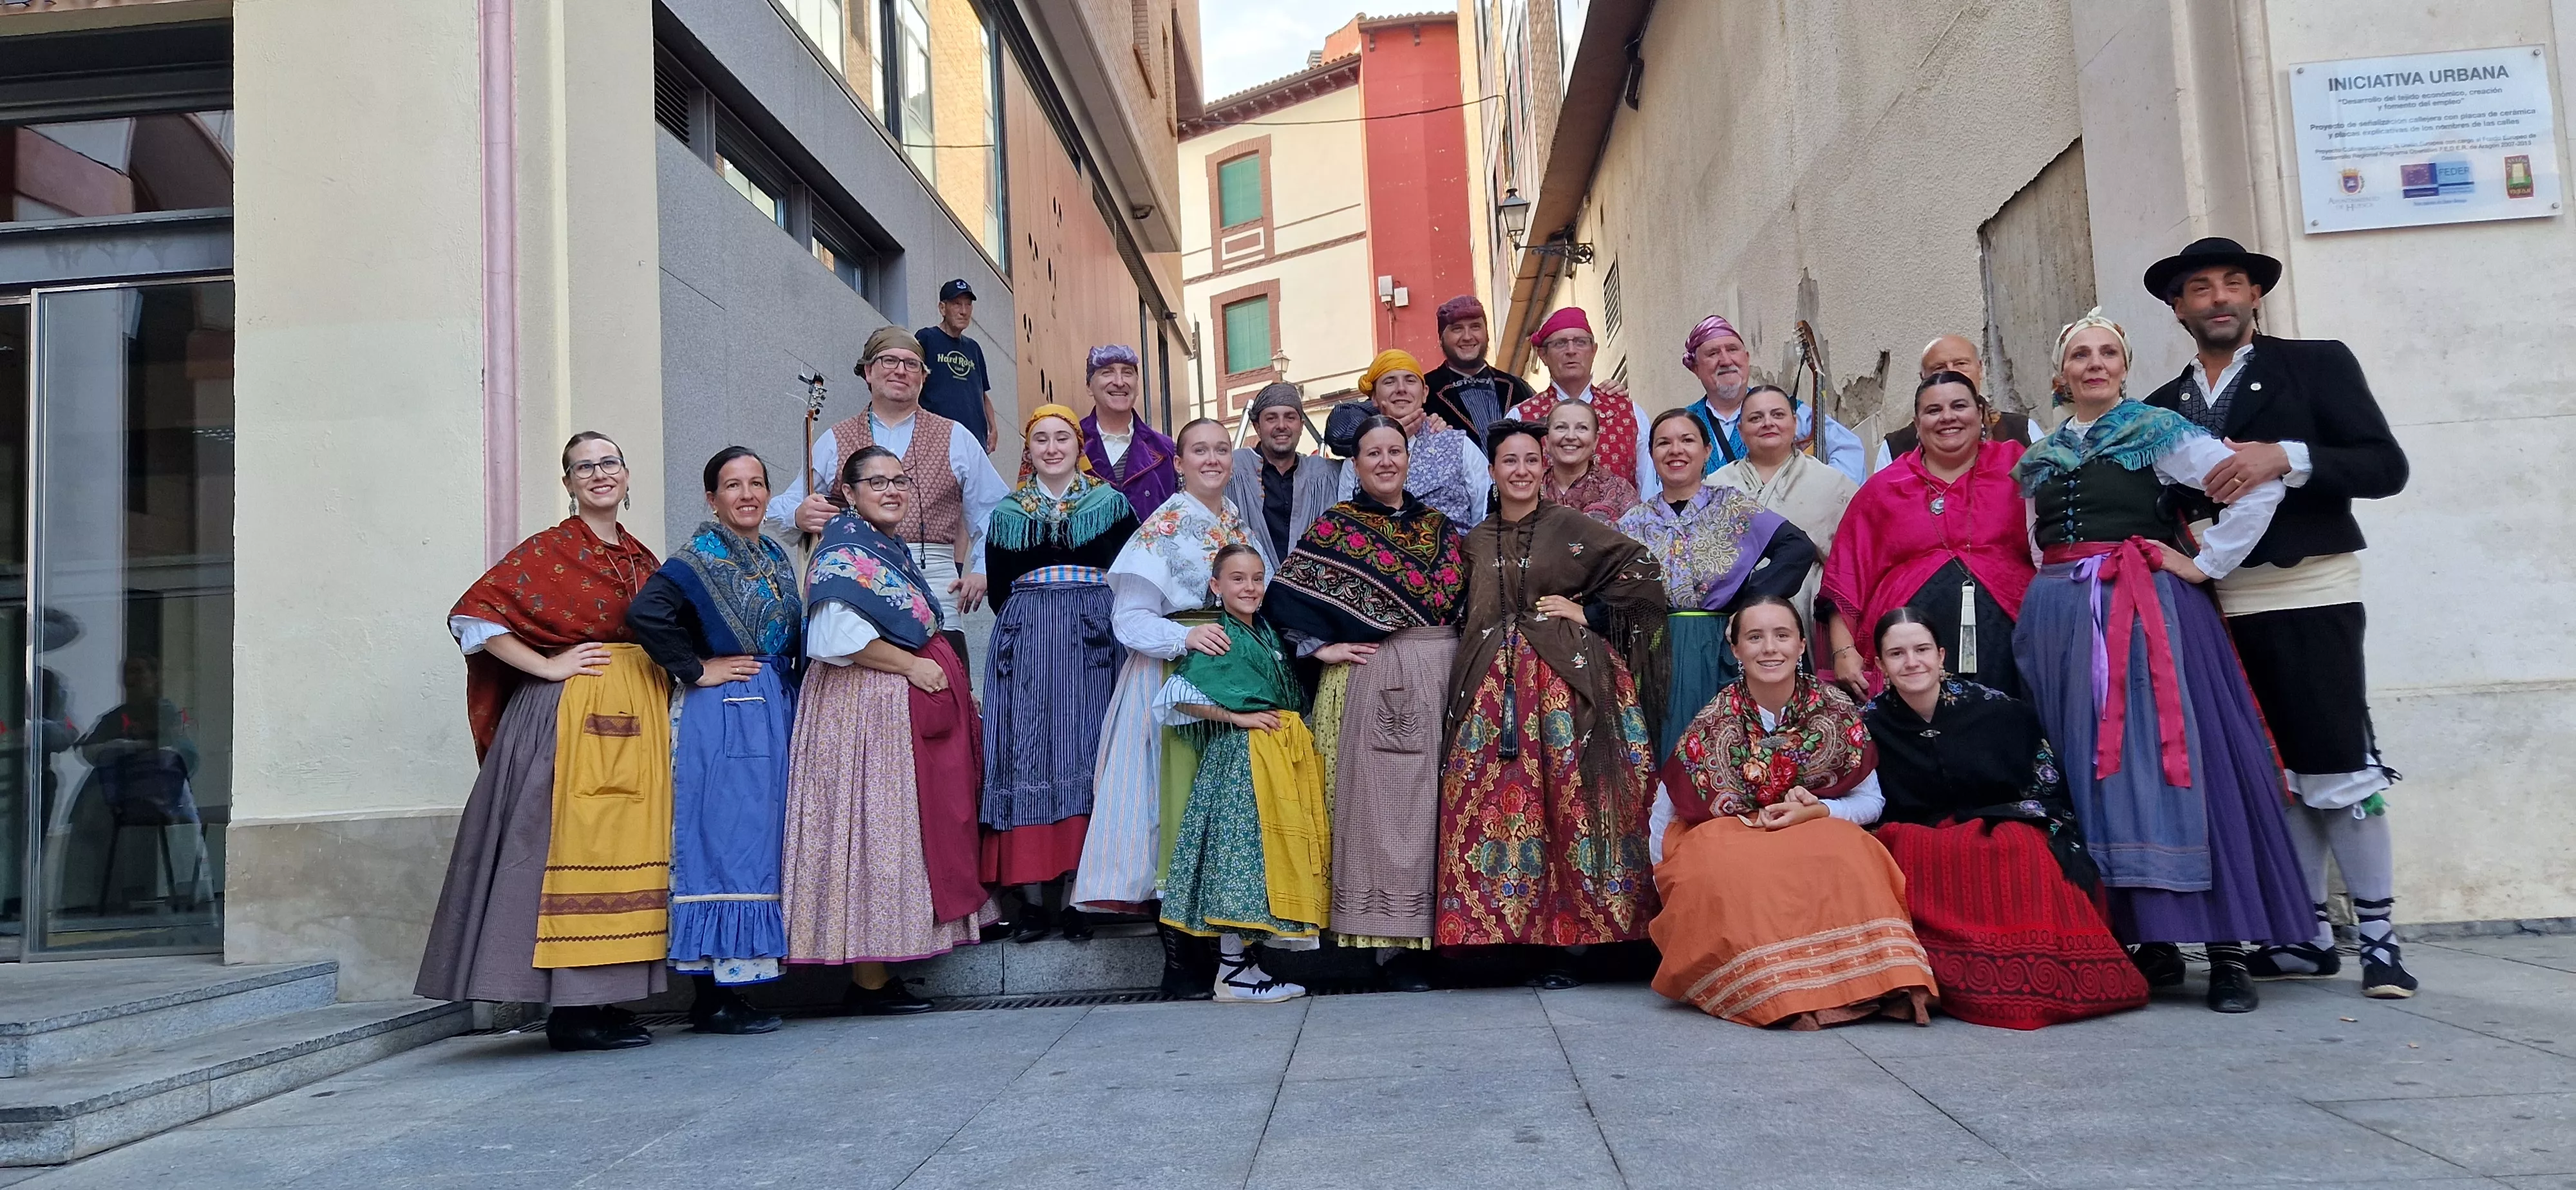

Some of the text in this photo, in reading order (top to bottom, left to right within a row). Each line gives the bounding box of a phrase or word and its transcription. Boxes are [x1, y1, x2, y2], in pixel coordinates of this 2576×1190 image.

[2328, 65, 2509, 91] INICIATIVA URBANA
[2421, 90, 2467, 99] económico,
[2469, 87, 2503, 95] creación
[2310, 123, 2345, 131] Proyecto
[2358, 117, 2407, 127] señalización
[2409, 115, 2441, 124] callejera
[2460, 111, 2486, 120] placas
[2334, 131, 2360, 139] placas
[2362, 128, 2408, 137] explicativas
[2438, 166, 2469, 176] FEDER
[937, 354, 976, 370] Hard Rock
